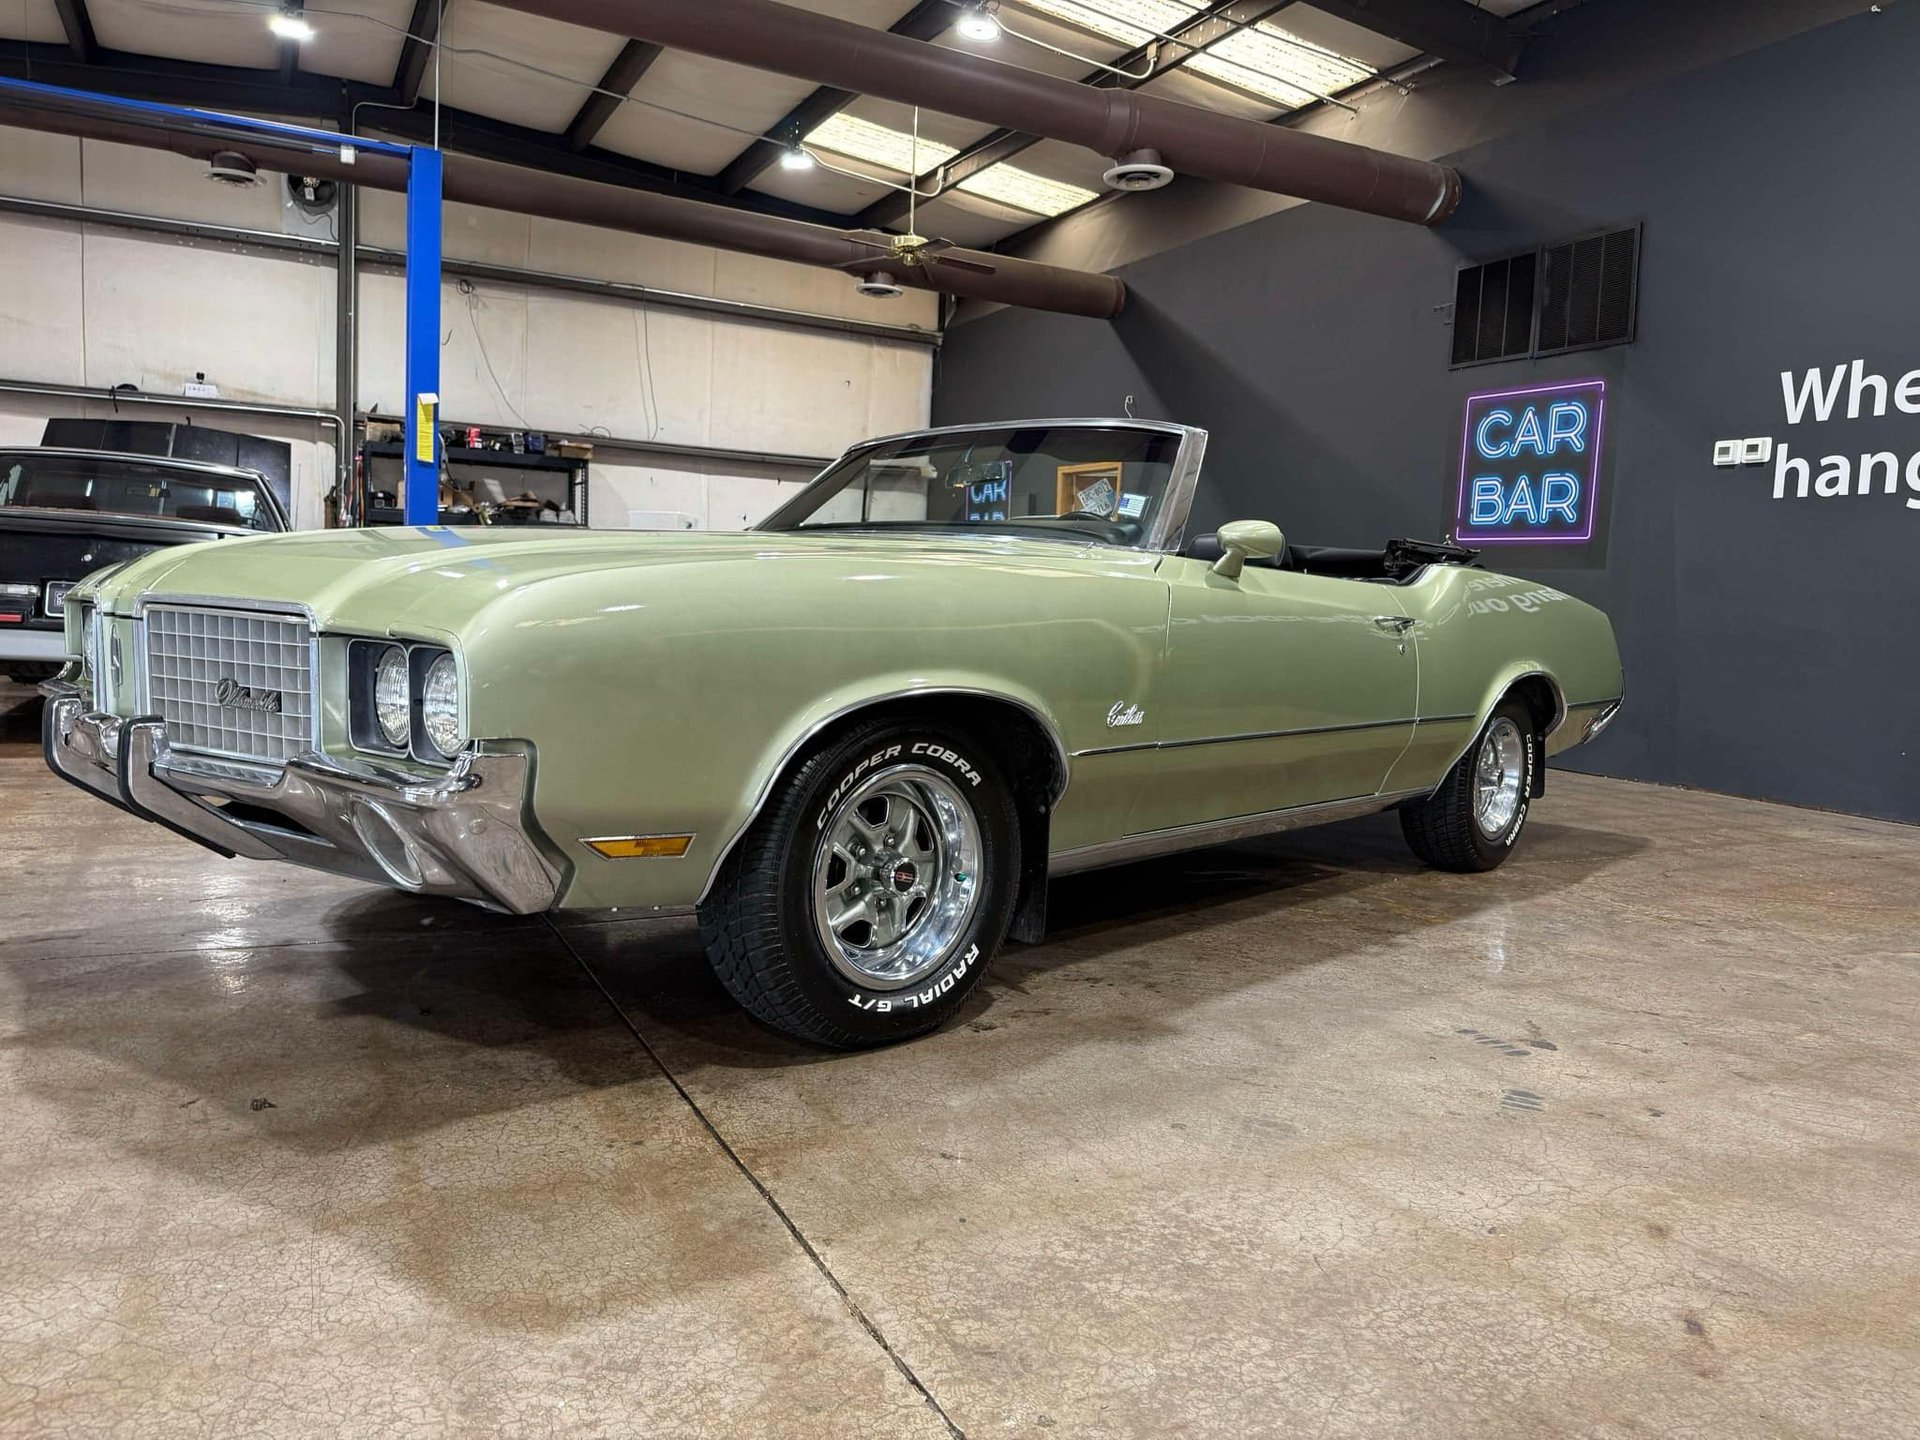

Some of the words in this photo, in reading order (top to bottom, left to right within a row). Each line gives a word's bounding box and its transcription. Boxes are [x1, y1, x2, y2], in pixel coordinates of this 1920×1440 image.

[1780, 359, 1920, 425] Whe
[1477, 402, 1587, 459] CAR
[1470, 473, 1580, 525] BAR
[816, 744, 902, 830] COOPER
[911, 742, 982, 787] COBRA
[847, 993, 892, 1013] G/T
[903, 942, 980, 1009] RADIAL
